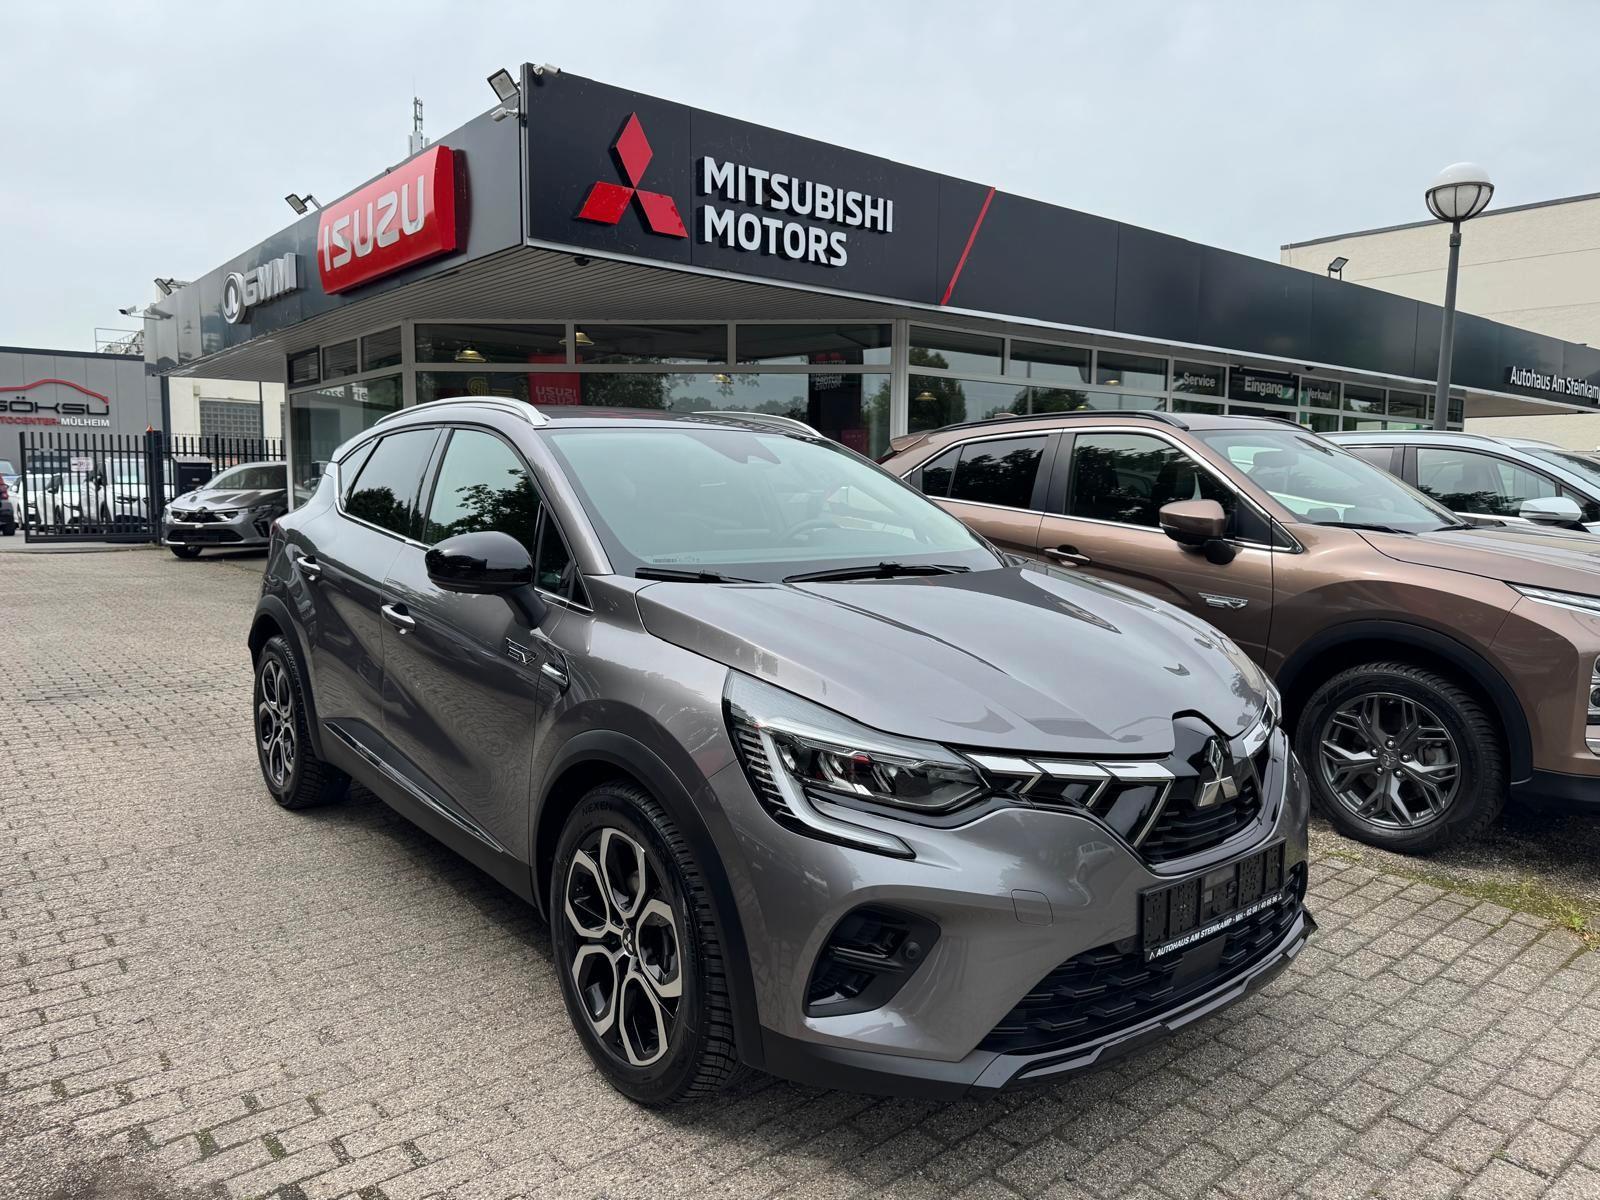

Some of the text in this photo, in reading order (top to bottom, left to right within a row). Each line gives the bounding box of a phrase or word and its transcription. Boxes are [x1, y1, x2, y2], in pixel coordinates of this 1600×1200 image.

[704, 156, 893, 233] MITSUBISHI
[323, 175, 426, 272] ISUZU
[704, 204, 848, 267] MOTORS
[241, 252, 297, 306] GWM
[1183, 372, 1216, 388] Service
[1244, 376, 1283, 397] Eingang
[1510, 366, 1600, 405] Autohaus Am Steinkam
[1155, 936, 1190, 957] AUTOHAUS
[1189, 931, 1200, 944] AM
[1200, 917, 1232, 938] STEINKAMP
